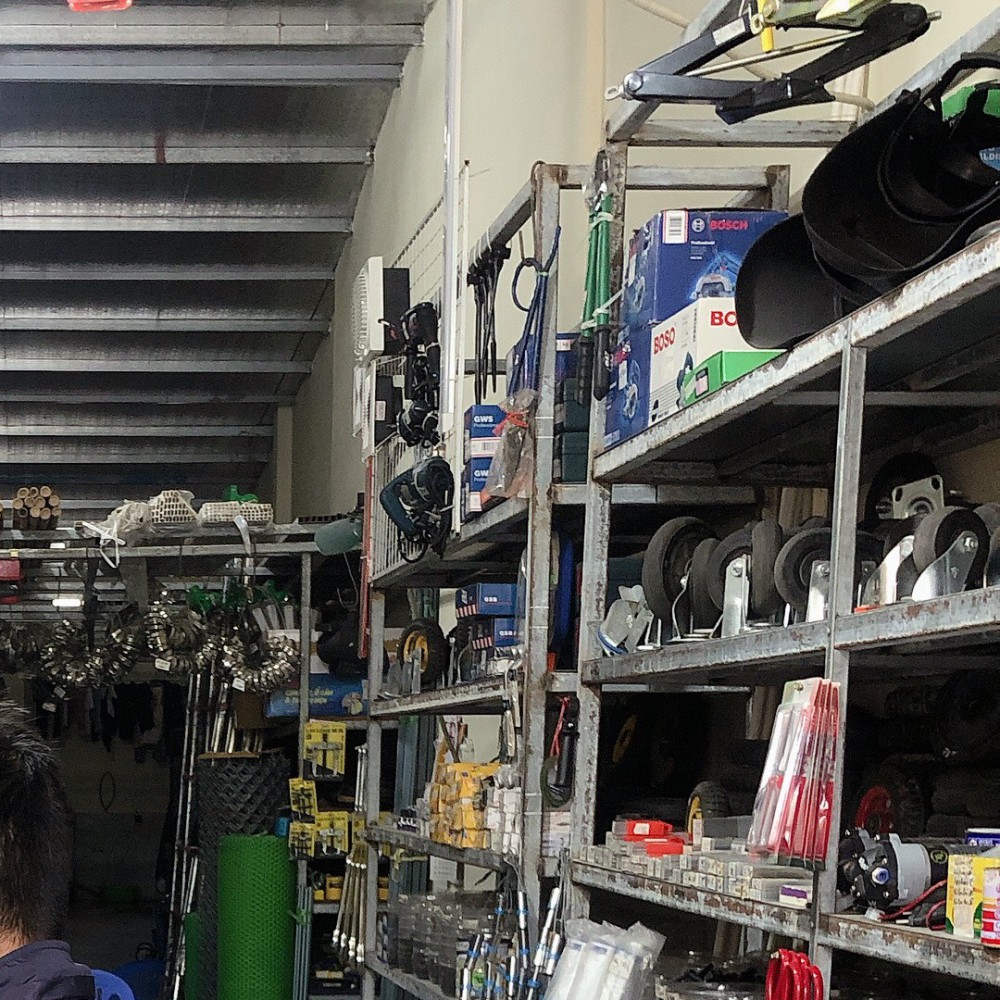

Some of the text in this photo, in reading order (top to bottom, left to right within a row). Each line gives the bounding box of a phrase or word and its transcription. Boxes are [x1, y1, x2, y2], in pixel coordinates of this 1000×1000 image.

[709, 219, 748, 231] BOSCH
[652, 326, 676, 355] BOSO
[473, 415, 494, 423] GWS
[473, 470, 490, 478] GW
